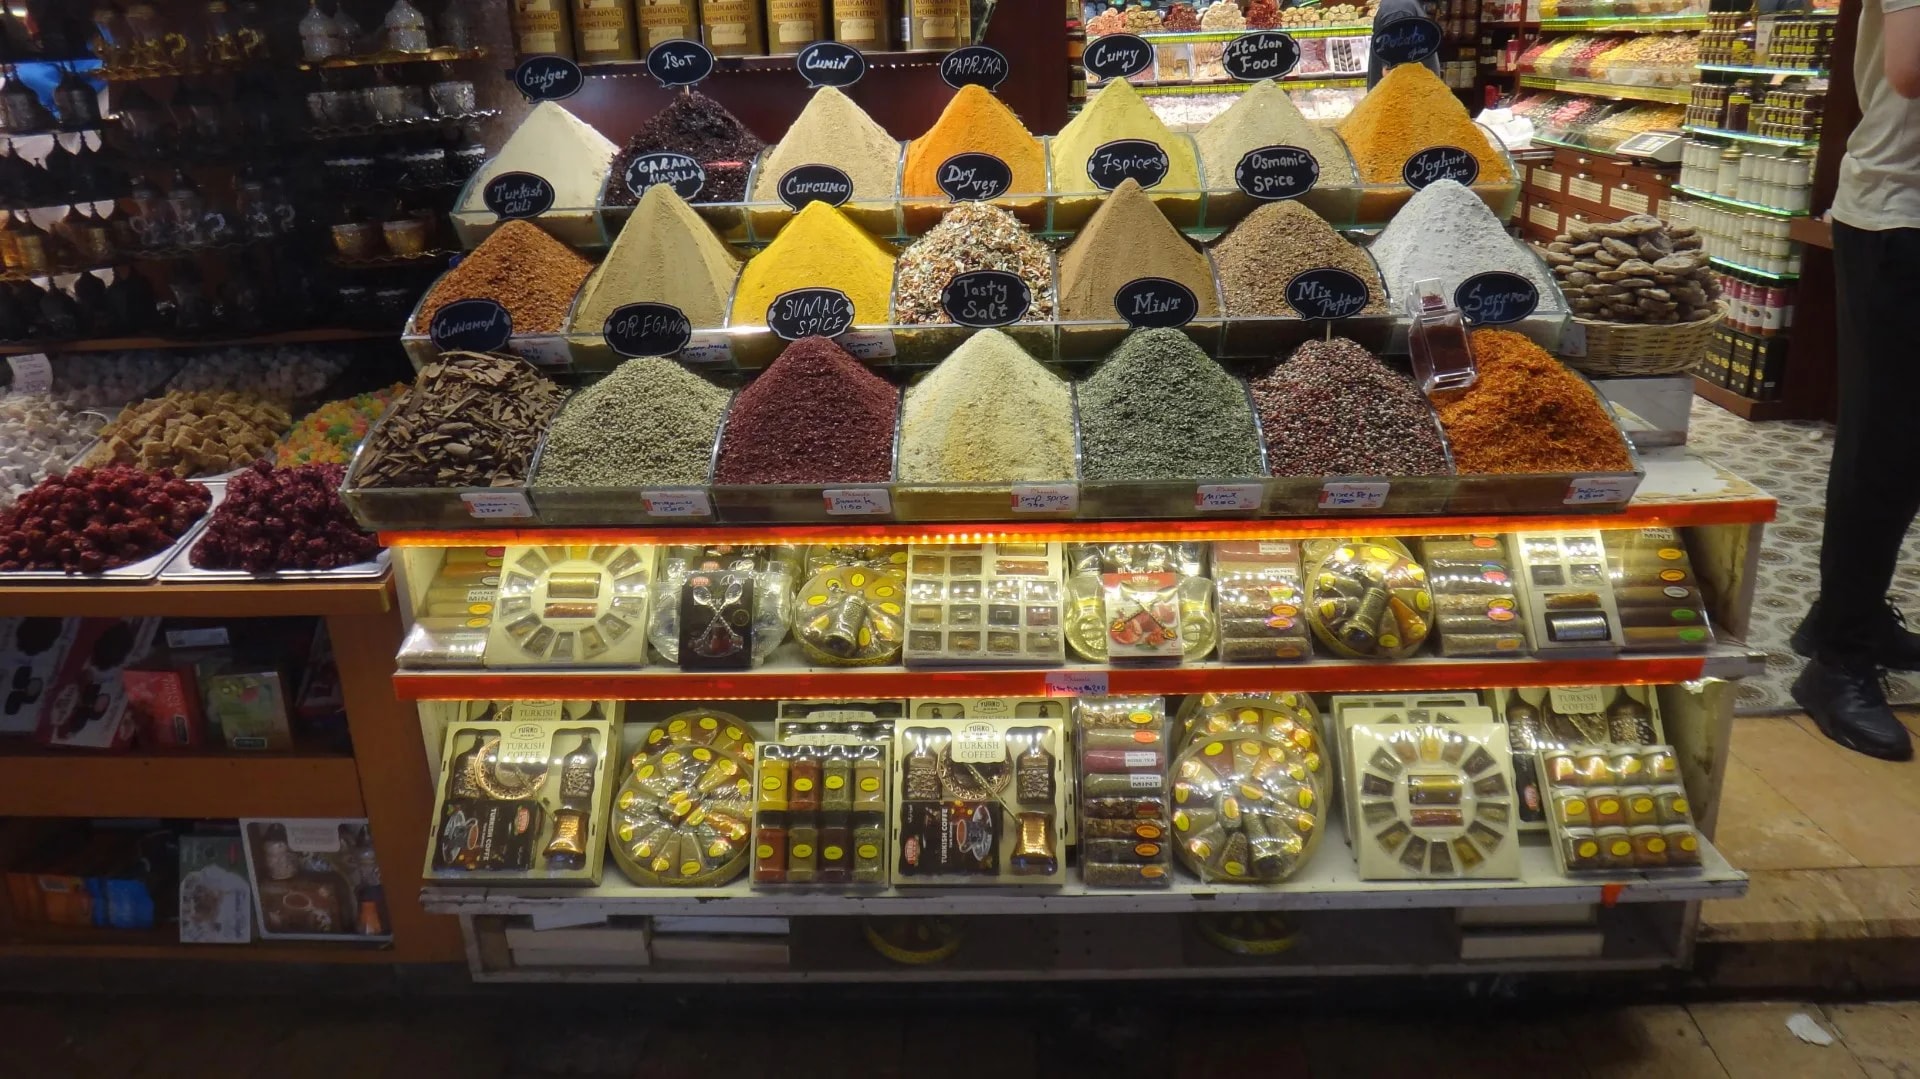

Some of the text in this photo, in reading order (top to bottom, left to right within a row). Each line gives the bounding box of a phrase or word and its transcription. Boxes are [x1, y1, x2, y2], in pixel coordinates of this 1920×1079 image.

[1231, 35, 1283, 57] Italian
[946, 55, 1002, 76] PAPRIKA
[1095, 45, 1140, 73] Curry
[1240, 54, 1279, 73] Food
[638, 157, 692, 174] GARAM
[1251, 151, 1307, 170] Osmanic
[1411, 151, 1468, 181] Yoghurt
[649, 169, 697, 184] MASALA
[944, 165, 976, 191] Dry
[1254, 174, 1296, 193] Spice
[494, 181, 543, 203] Turkish
[957, 278, 1008, 304] Tasty
[1295, 281, 1332, 301] Mix
[783, 295, 842, 320] SUMAC
[962, 301, 1008, 321] Salt
[1316, 293, 1364, 316] Pepper
[616, 314, 685, 338] OREGANO
[795, 316, 844, 336] SPICE
[507, 742, 545, 750] TURKISH
[959, 741, 999, 750] TURKISH
[961, 750, 997, 759] COFFEE
